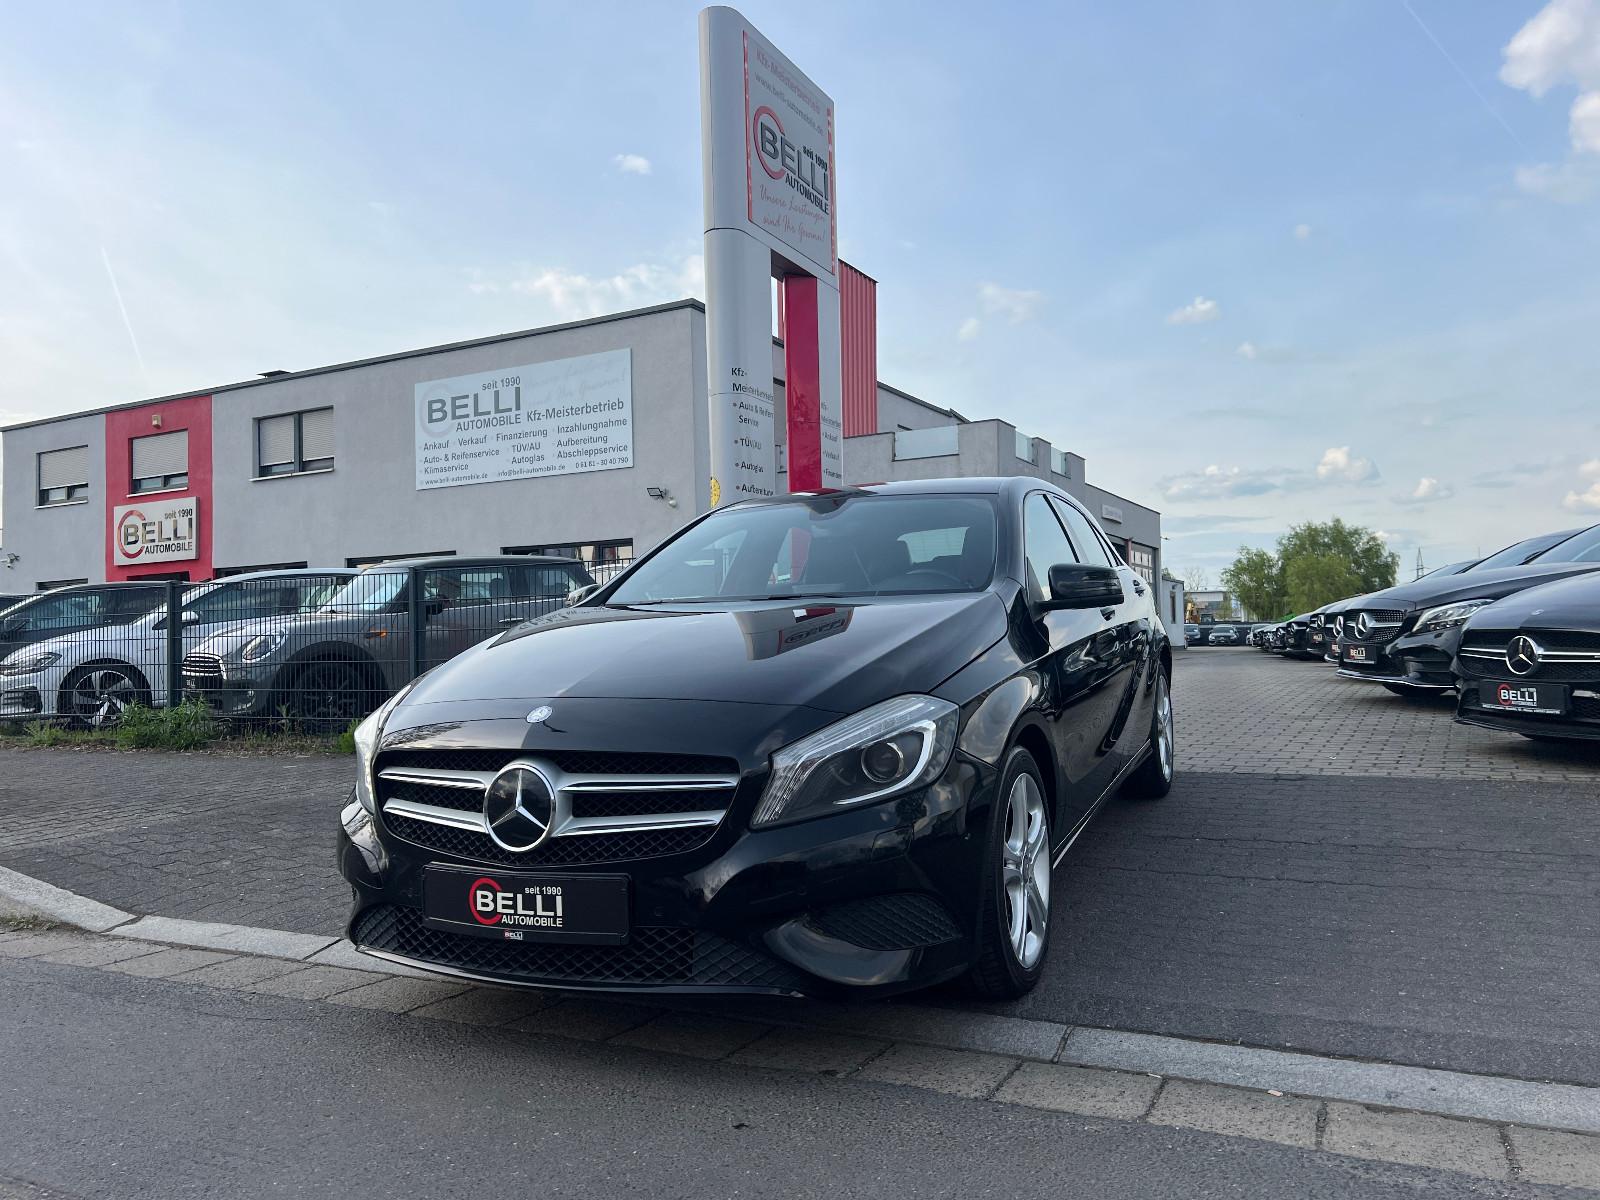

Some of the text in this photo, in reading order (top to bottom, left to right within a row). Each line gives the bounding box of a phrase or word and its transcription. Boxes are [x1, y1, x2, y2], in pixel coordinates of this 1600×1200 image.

[760, 121, 829, 201] BELLI
[814, 153, 828, 172] 1990
[785, 172, 829, 216] AUTOMOBILE
[482, 376, 521, 391] seit 1990
[427, 386, 521, 424] BELLI
[526, 398, 624, 422] Kfz-Meisterbetrieb
[455, 413, 522, 432] AUTOMOBILE
[423, 417, 628, 451] Ankauf Verkauf Finanzierung Inzahlungnahme
[556, 435, 608, 448] Aufbereitung
[511, 441, 541, 453] TÜV/AU
[556, 444, 628, 460] Abschleppservice
[443, 453, 450, 462] &
[451, 448, 500, 462] Reifenservice
[511, 453, 545, 465] Autoglas
[424, 463, 469, 475] Klimaservice
[165, 508, 193, 519] seit 1990
[124, 517, 193, 546] BELLI
[144, 542, 193, 555] AUTOMOBILE
[1500, 689, 1537, 702] BELLI
[525, 886, 562, 895] seit 1990
[476, 890, 563, 917] BELLI
[501, 915, 563, 928] AUTOMOBILE
